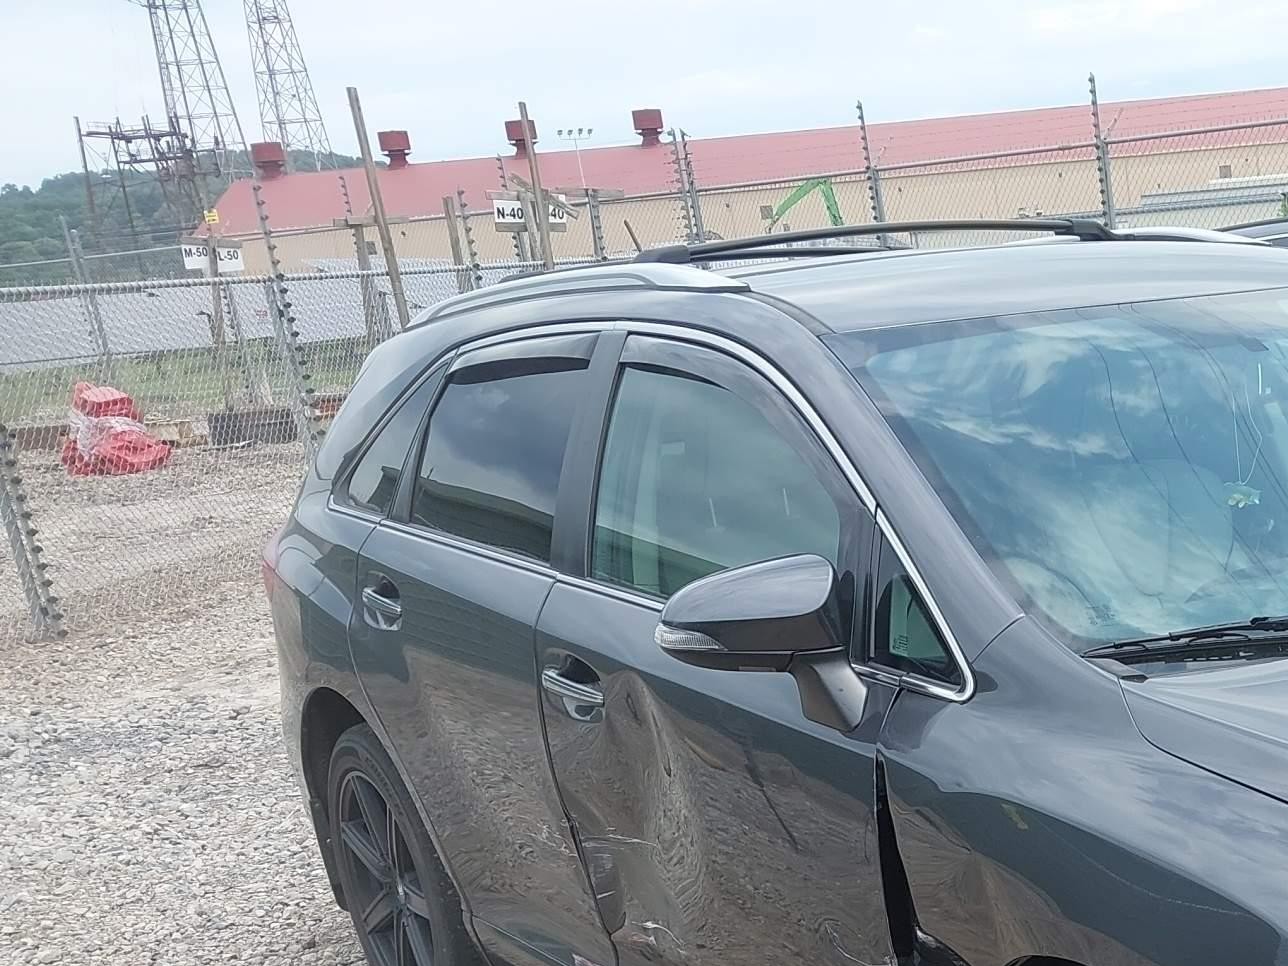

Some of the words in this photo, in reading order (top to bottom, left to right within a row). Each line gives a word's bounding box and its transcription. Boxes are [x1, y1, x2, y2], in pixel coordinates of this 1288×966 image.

[496, 206, 524, 219] N-40
[184, 246, 208, 258] M-50
[217, 249, 239, 261] L-50
